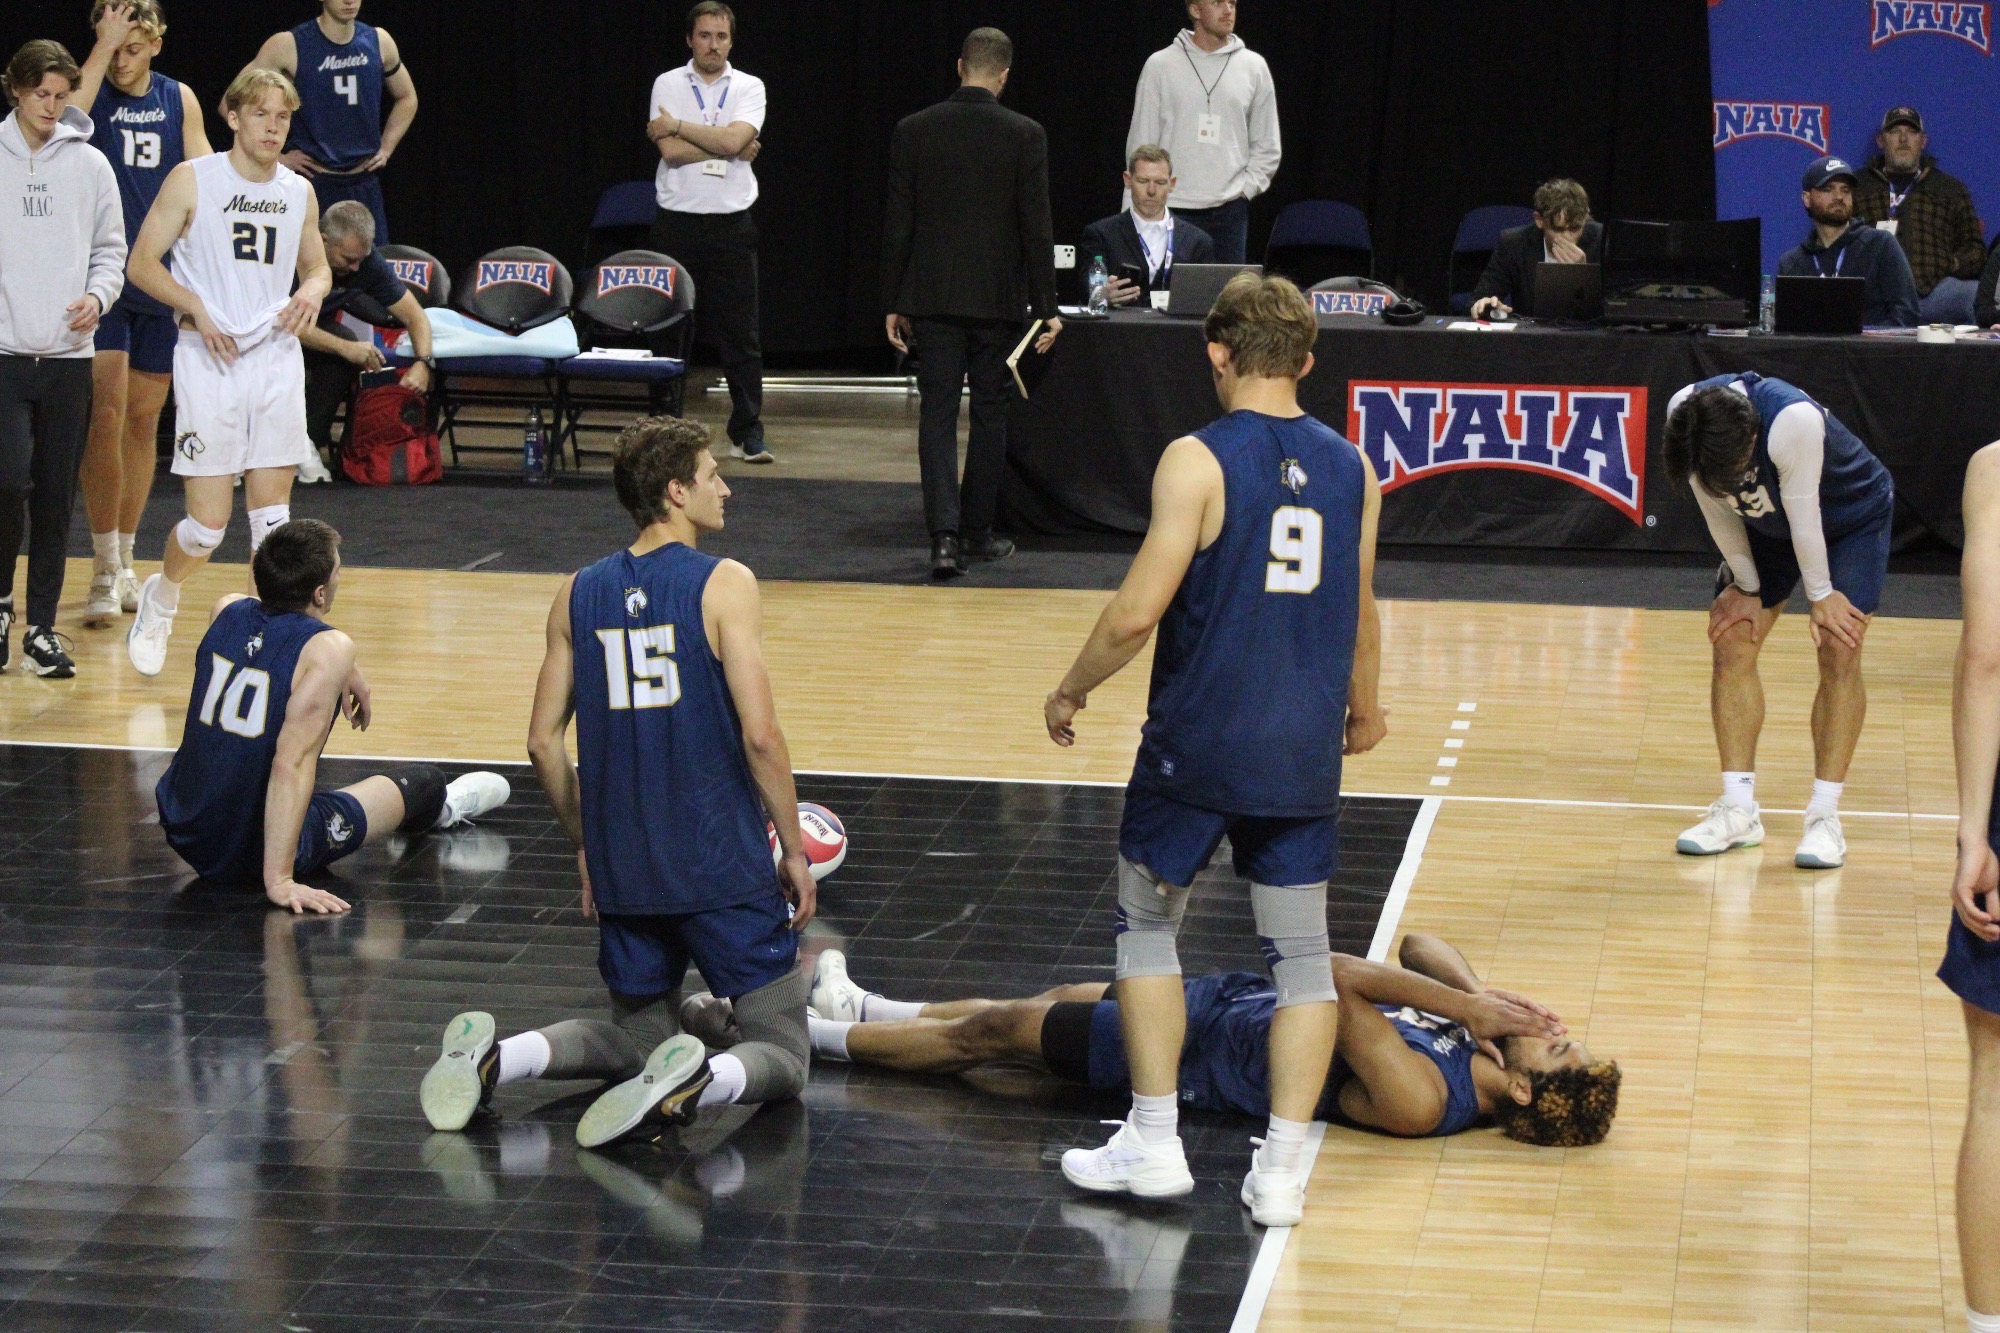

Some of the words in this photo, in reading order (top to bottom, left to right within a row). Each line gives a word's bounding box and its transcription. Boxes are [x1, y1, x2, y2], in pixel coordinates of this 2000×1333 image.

[1872, 1, 1989, 51] NAIA
[318, 53, 369, 71] Master's
[333, 75, 357, 105] 4
[110, 107, 166, 124] Master's
[1713, 102, 1827, 153] NAIA
[120, 129, 161, 168] 13
[27, 184, 47, 192] THE
[22, 197, 53, 217] MAC
[223, 195, 288, 215] Master's
[232, 222, 277, 265] 21
[385, 259, 429, 289] IA
[477, 261, 551, 295] NAIA
[599, 265, 674, 298] NAIA
[1312, 292, 1386, 316] NAIA
[1353, 386, 1638, 510] NAIA
[1265, 506, 1323, 595] 9
[595, 624, 682, 710] 15
[199, 652, 271, 739] 10
